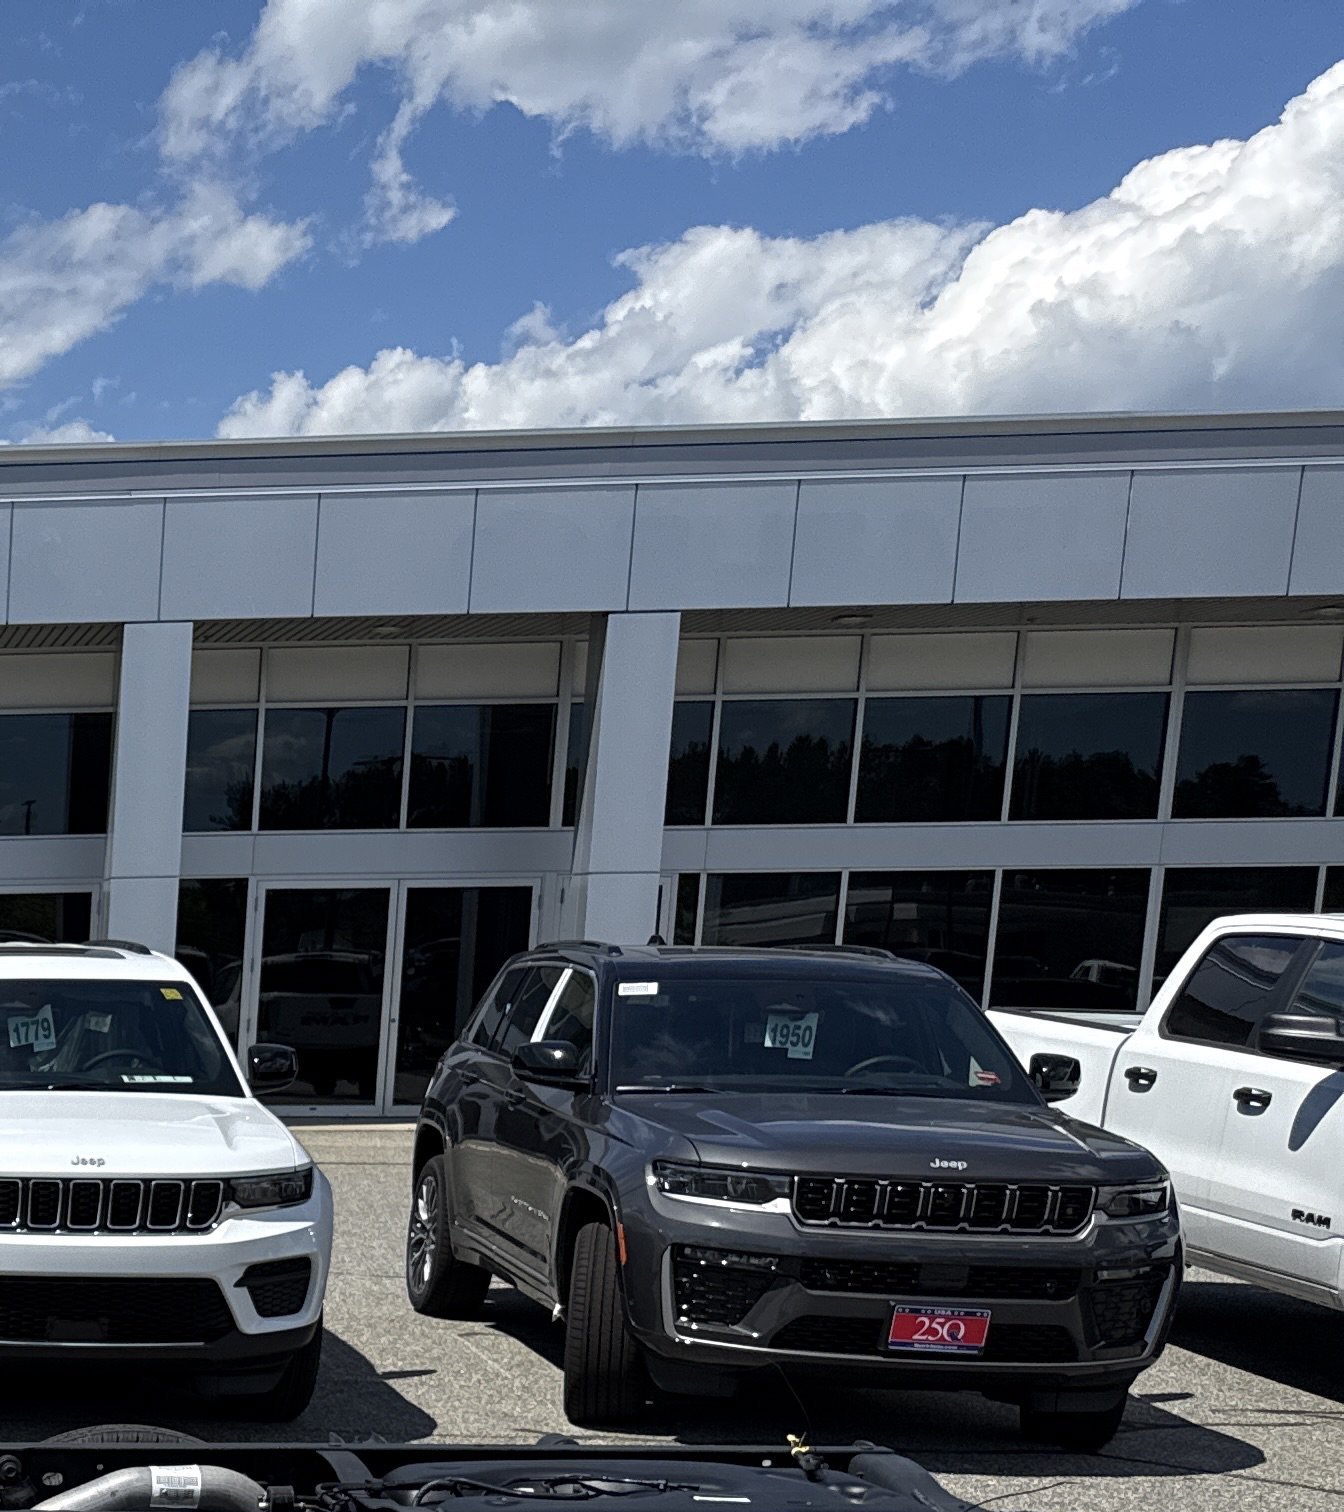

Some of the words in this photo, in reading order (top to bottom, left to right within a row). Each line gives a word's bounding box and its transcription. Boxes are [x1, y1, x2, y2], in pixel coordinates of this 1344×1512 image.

[13, 1017, 52, 1044] 1779
[770, 1023, 812, 1048] 1950
[70, 1155, 105, 1168] Jeep
[929, 1157, 968, 1171] Jeep
[1291, 1208, 1331, 1230] RAM
